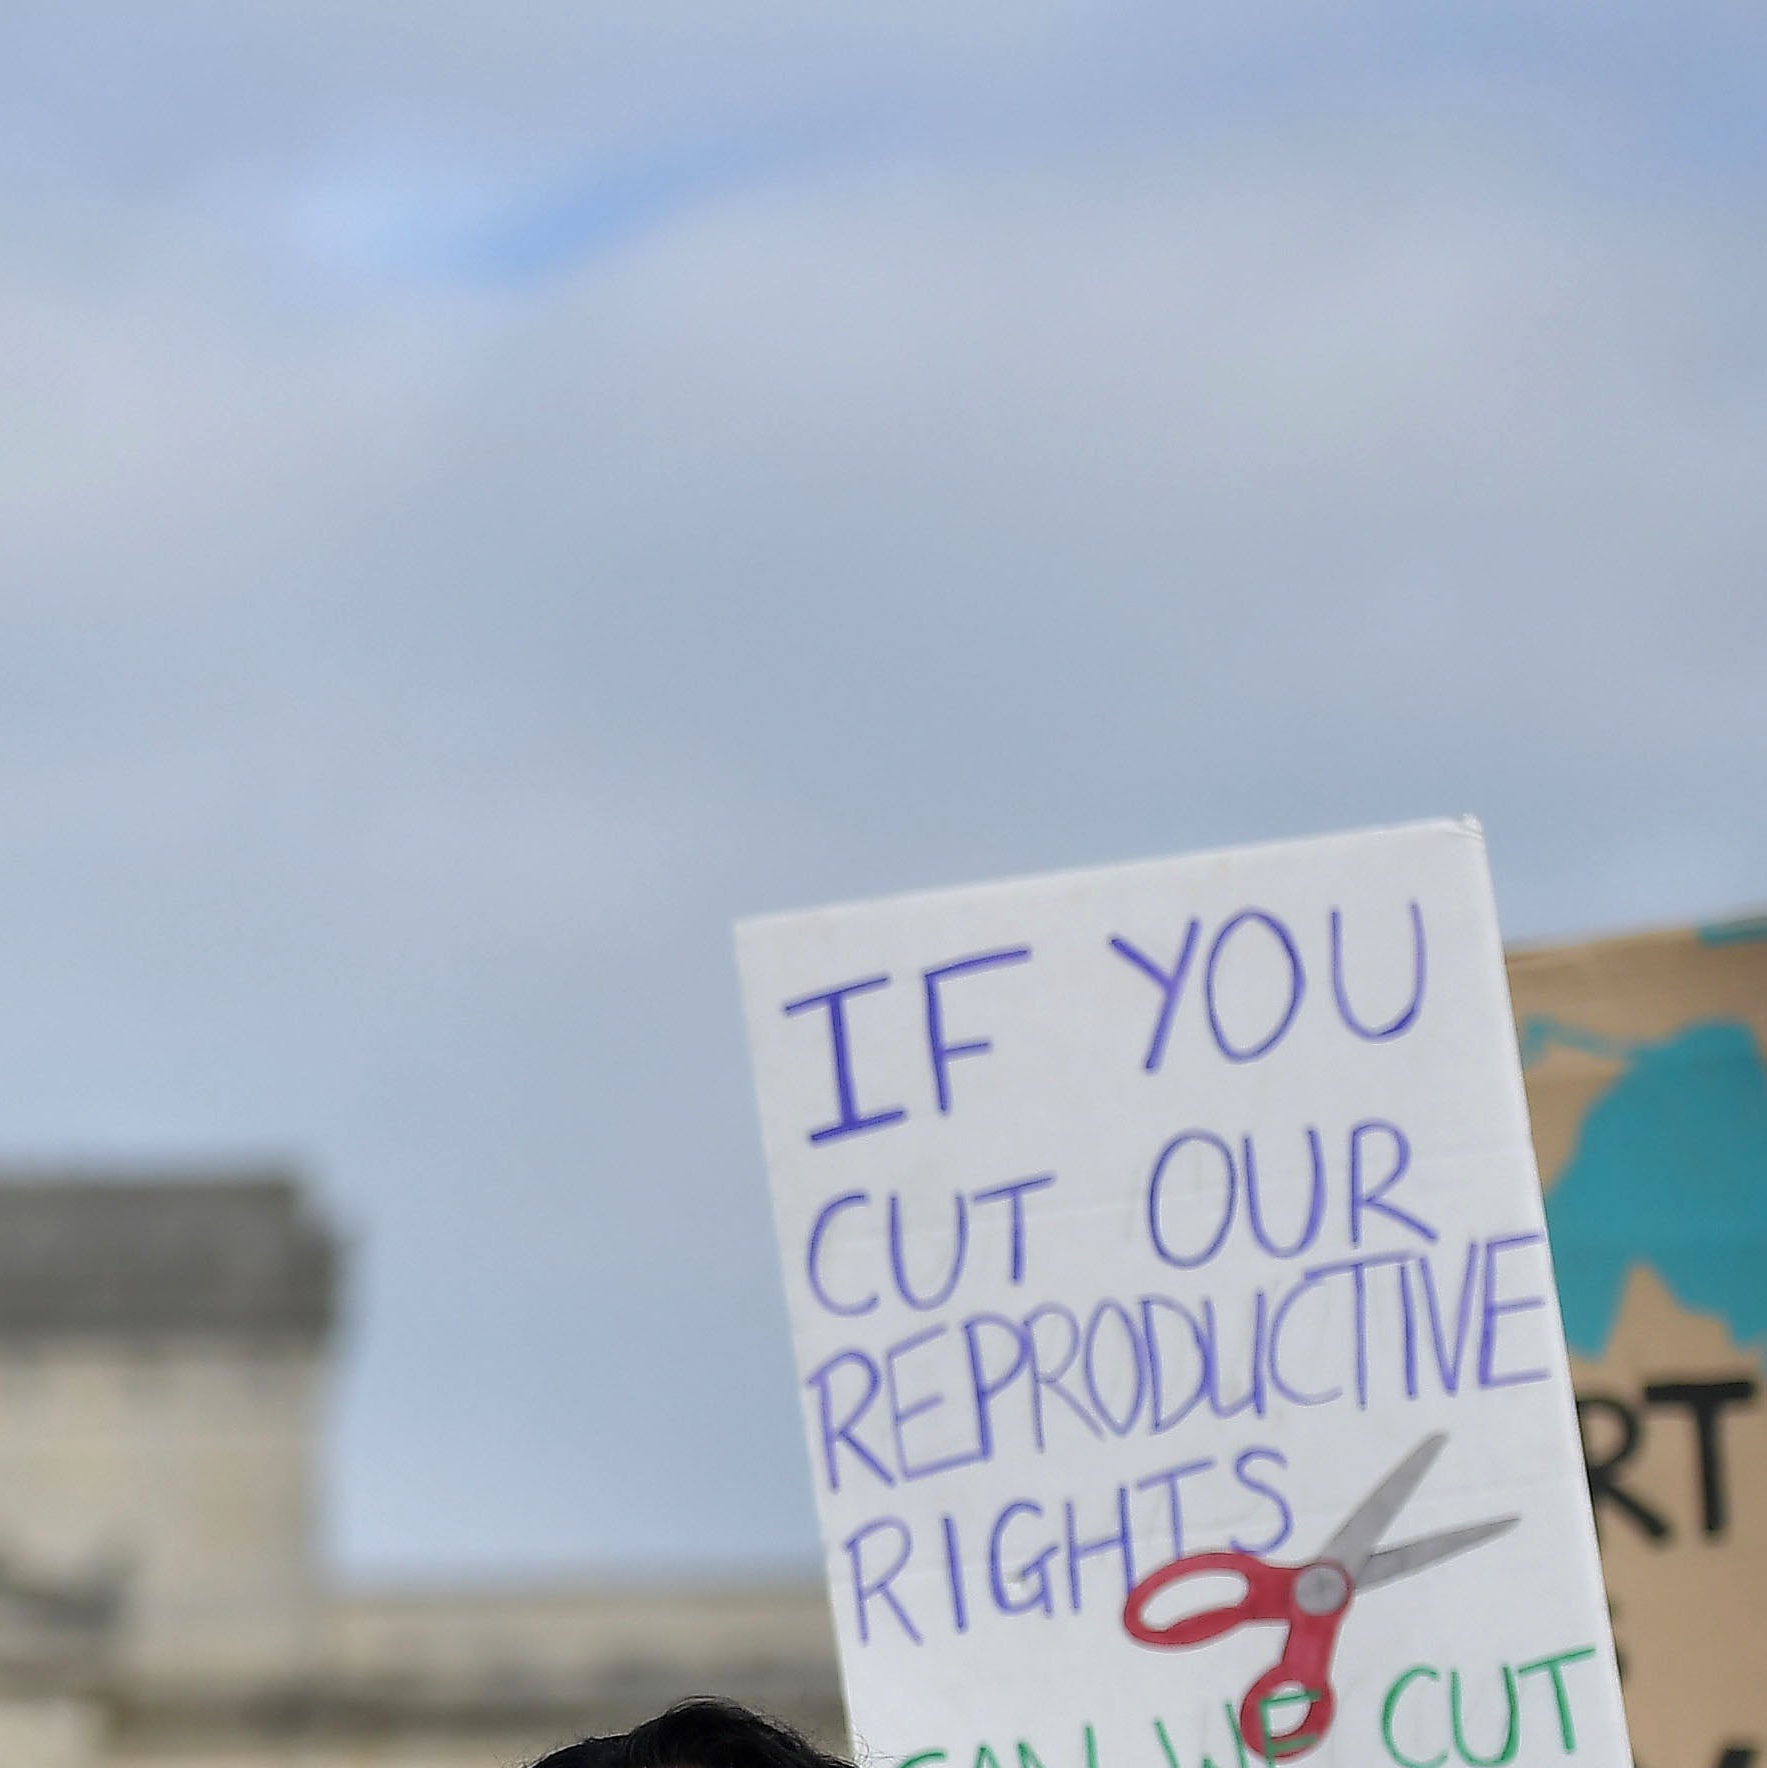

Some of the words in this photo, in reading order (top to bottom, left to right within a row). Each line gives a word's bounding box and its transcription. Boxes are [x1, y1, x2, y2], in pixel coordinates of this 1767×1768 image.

[783, 945, 1033, 1146] IF
[1108, 901, 1429, 1076] YOU
[805, 1171, 1058, 1318] CUT
[1146, 1119, 1440, 1270] OUR
[804, 1232, 1556, 1497] REPRODUCTIVE
[844, 1447, 1299, 1648] RIGHTS
